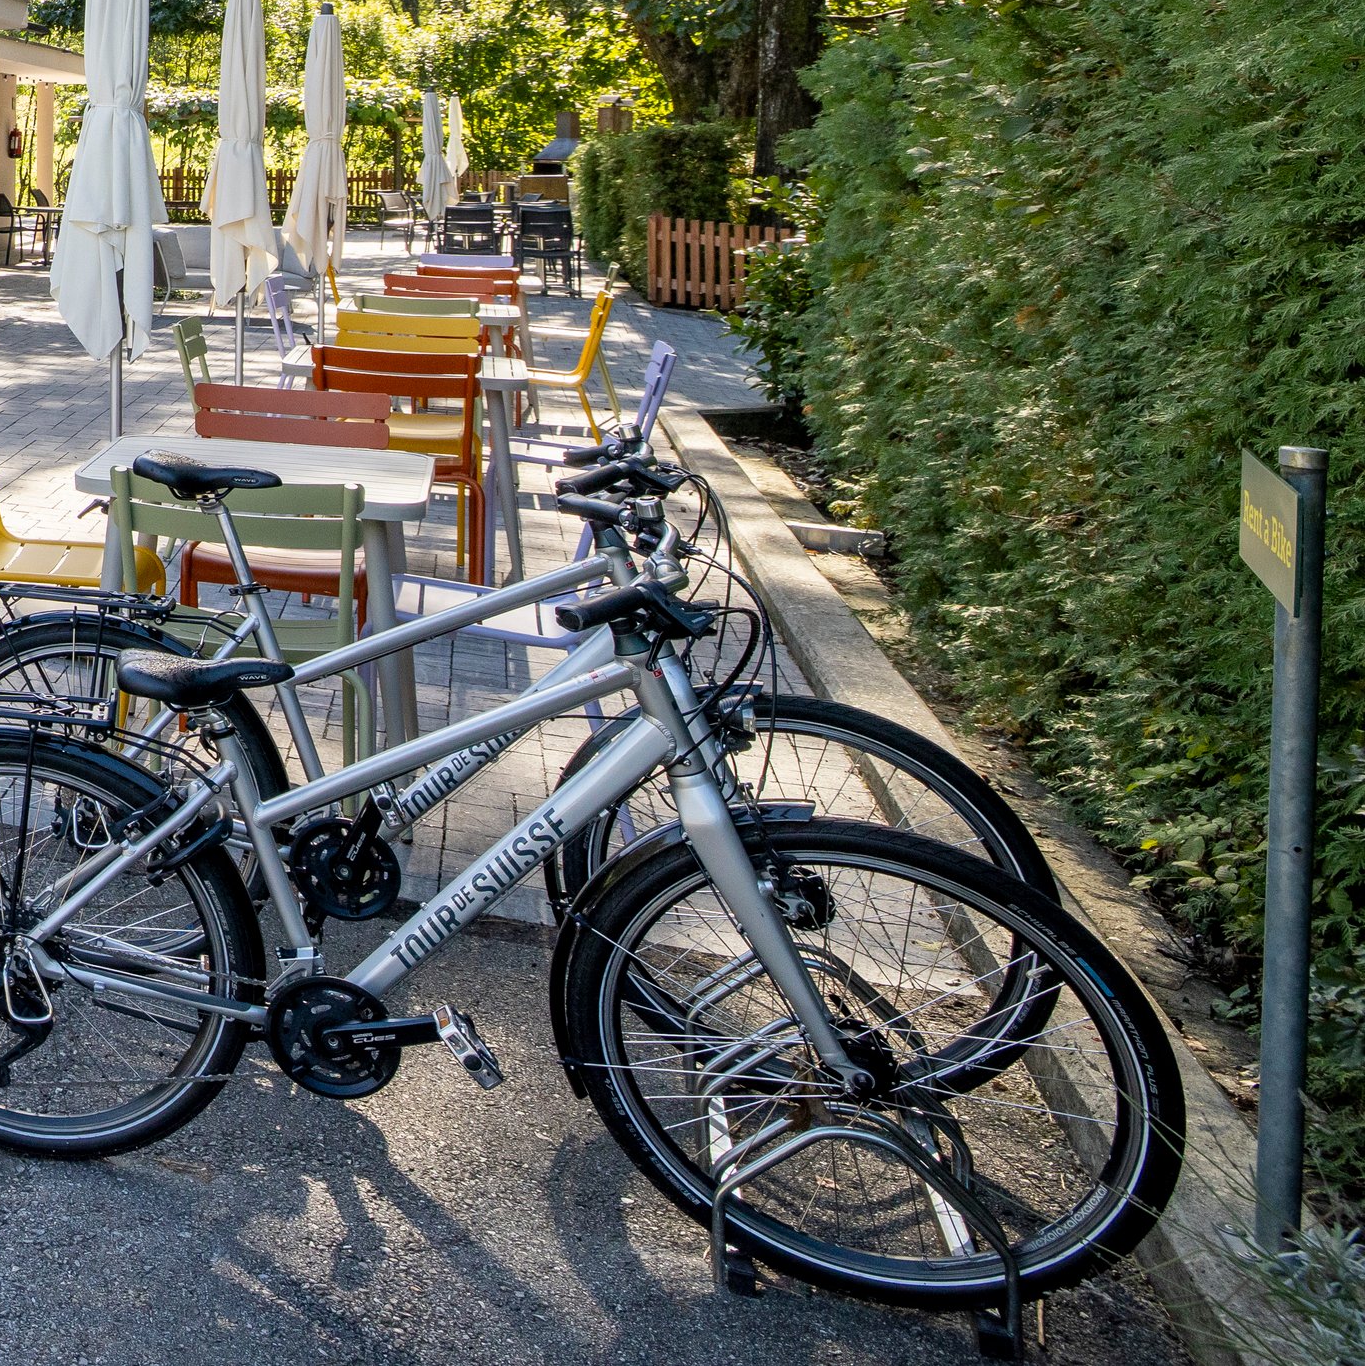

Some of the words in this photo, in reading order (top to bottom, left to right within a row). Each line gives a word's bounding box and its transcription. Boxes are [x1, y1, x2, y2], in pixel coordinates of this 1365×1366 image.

[1242, 489, 1264, 540] Rent
[1264, 517, 1270, 547] a
[1270, 515, 1292, 568] Bike
[399, 765, 459, 821] TOUR
[453, 750, 471, 773] DE
[349, 831, 367, 861] CUES
[390, 903, 462, 971] TOUR
[451, 885, 476, 912] DE
[471, 807, 571, 903] SUISSE
[1006, 903, 1078, 957] SCHWALBE
[1110, 998, 1150, 1060] MARATHON
[1144, 1062, 1158, 1095] PLUS
[352, 1033, 396, 1044] CUES
